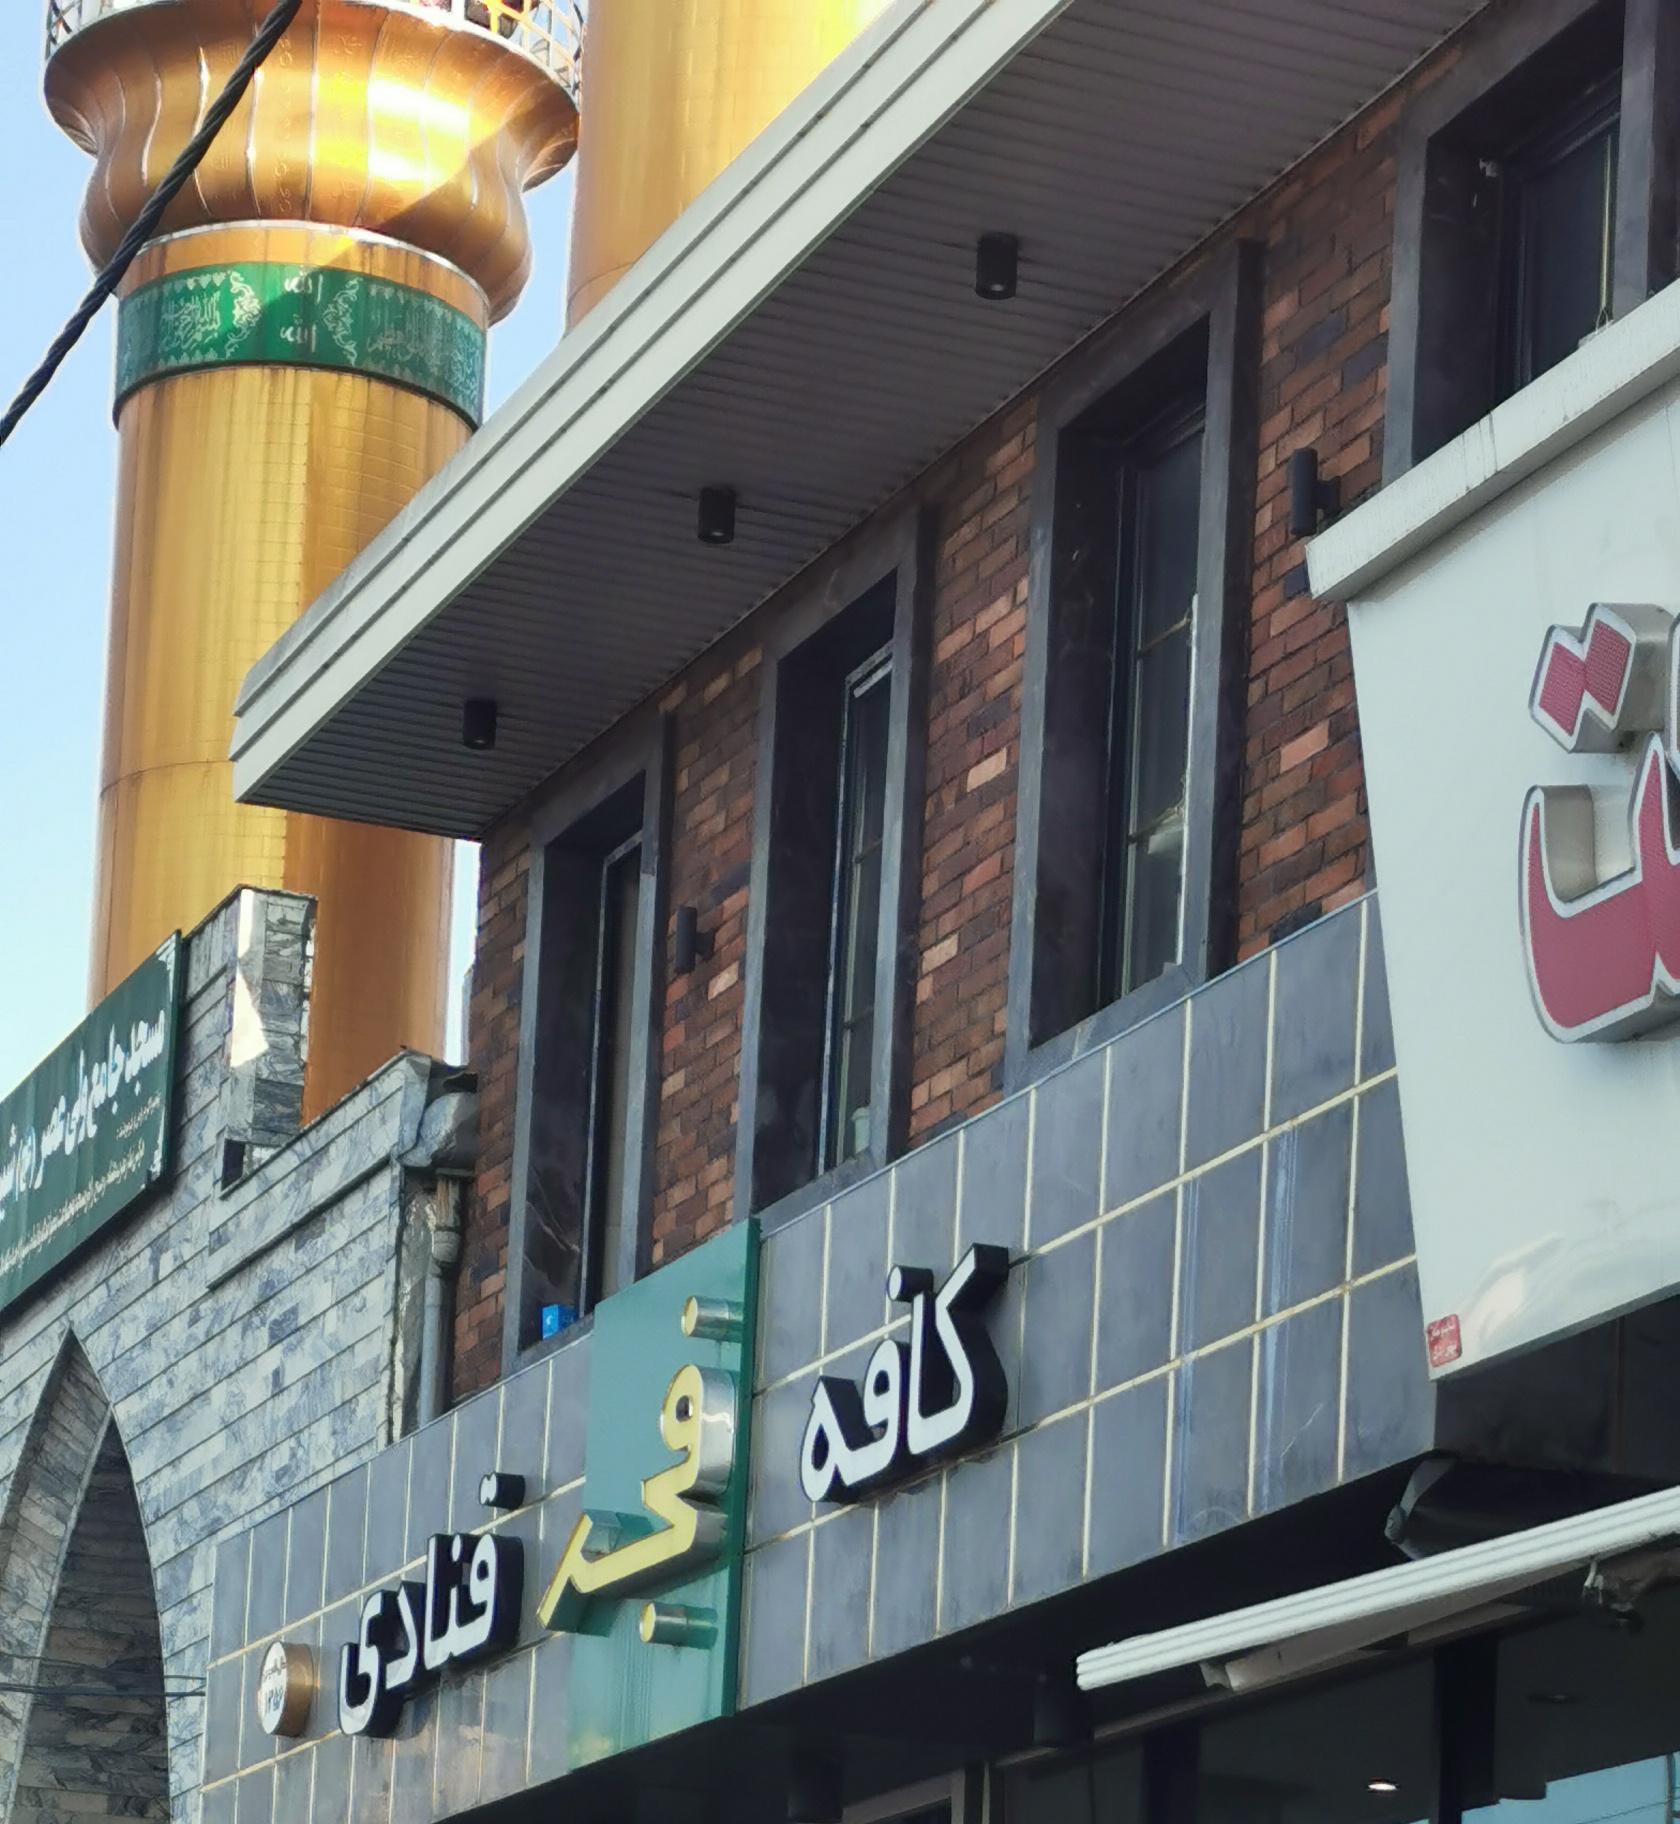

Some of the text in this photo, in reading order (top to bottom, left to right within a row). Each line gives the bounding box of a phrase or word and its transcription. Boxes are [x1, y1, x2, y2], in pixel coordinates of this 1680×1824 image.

[86, 1023, 126, 1139] جامع
[124, 1009, 165, 1097] مسجد
[33, 1095, 66, 1191] عصر
[337, 1243, 1009, 1738] کافه فجر قنادی
